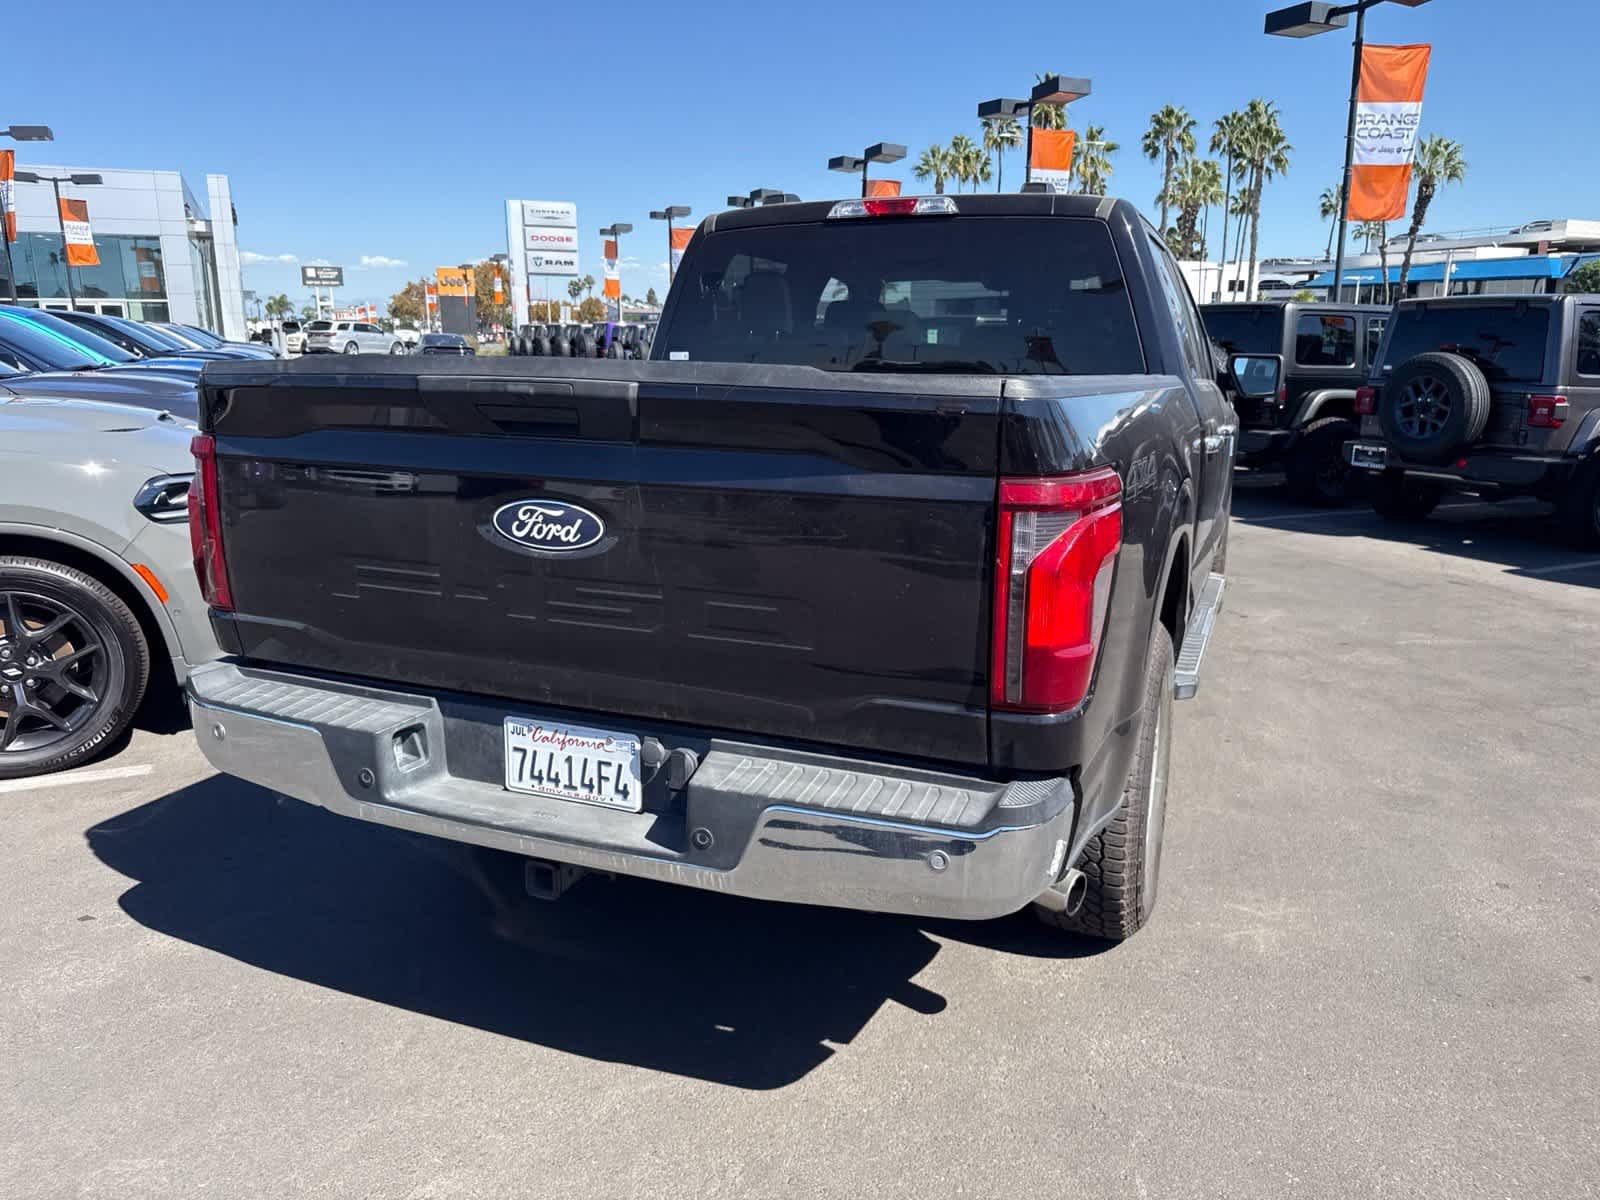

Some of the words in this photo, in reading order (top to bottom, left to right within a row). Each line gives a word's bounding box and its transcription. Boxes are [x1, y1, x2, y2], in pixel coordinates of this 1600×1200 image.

[1356, 127, 1413, 139] COAST
[531, 235, 573, 243] DODGE
[545, 259, 574, 267] RAM
[511, 505, 583, 543] Ford
[511, 725, 527, 737] JUL
[531, 726, 615, 753] California
[512, 746, 630, 800] 74414F4
